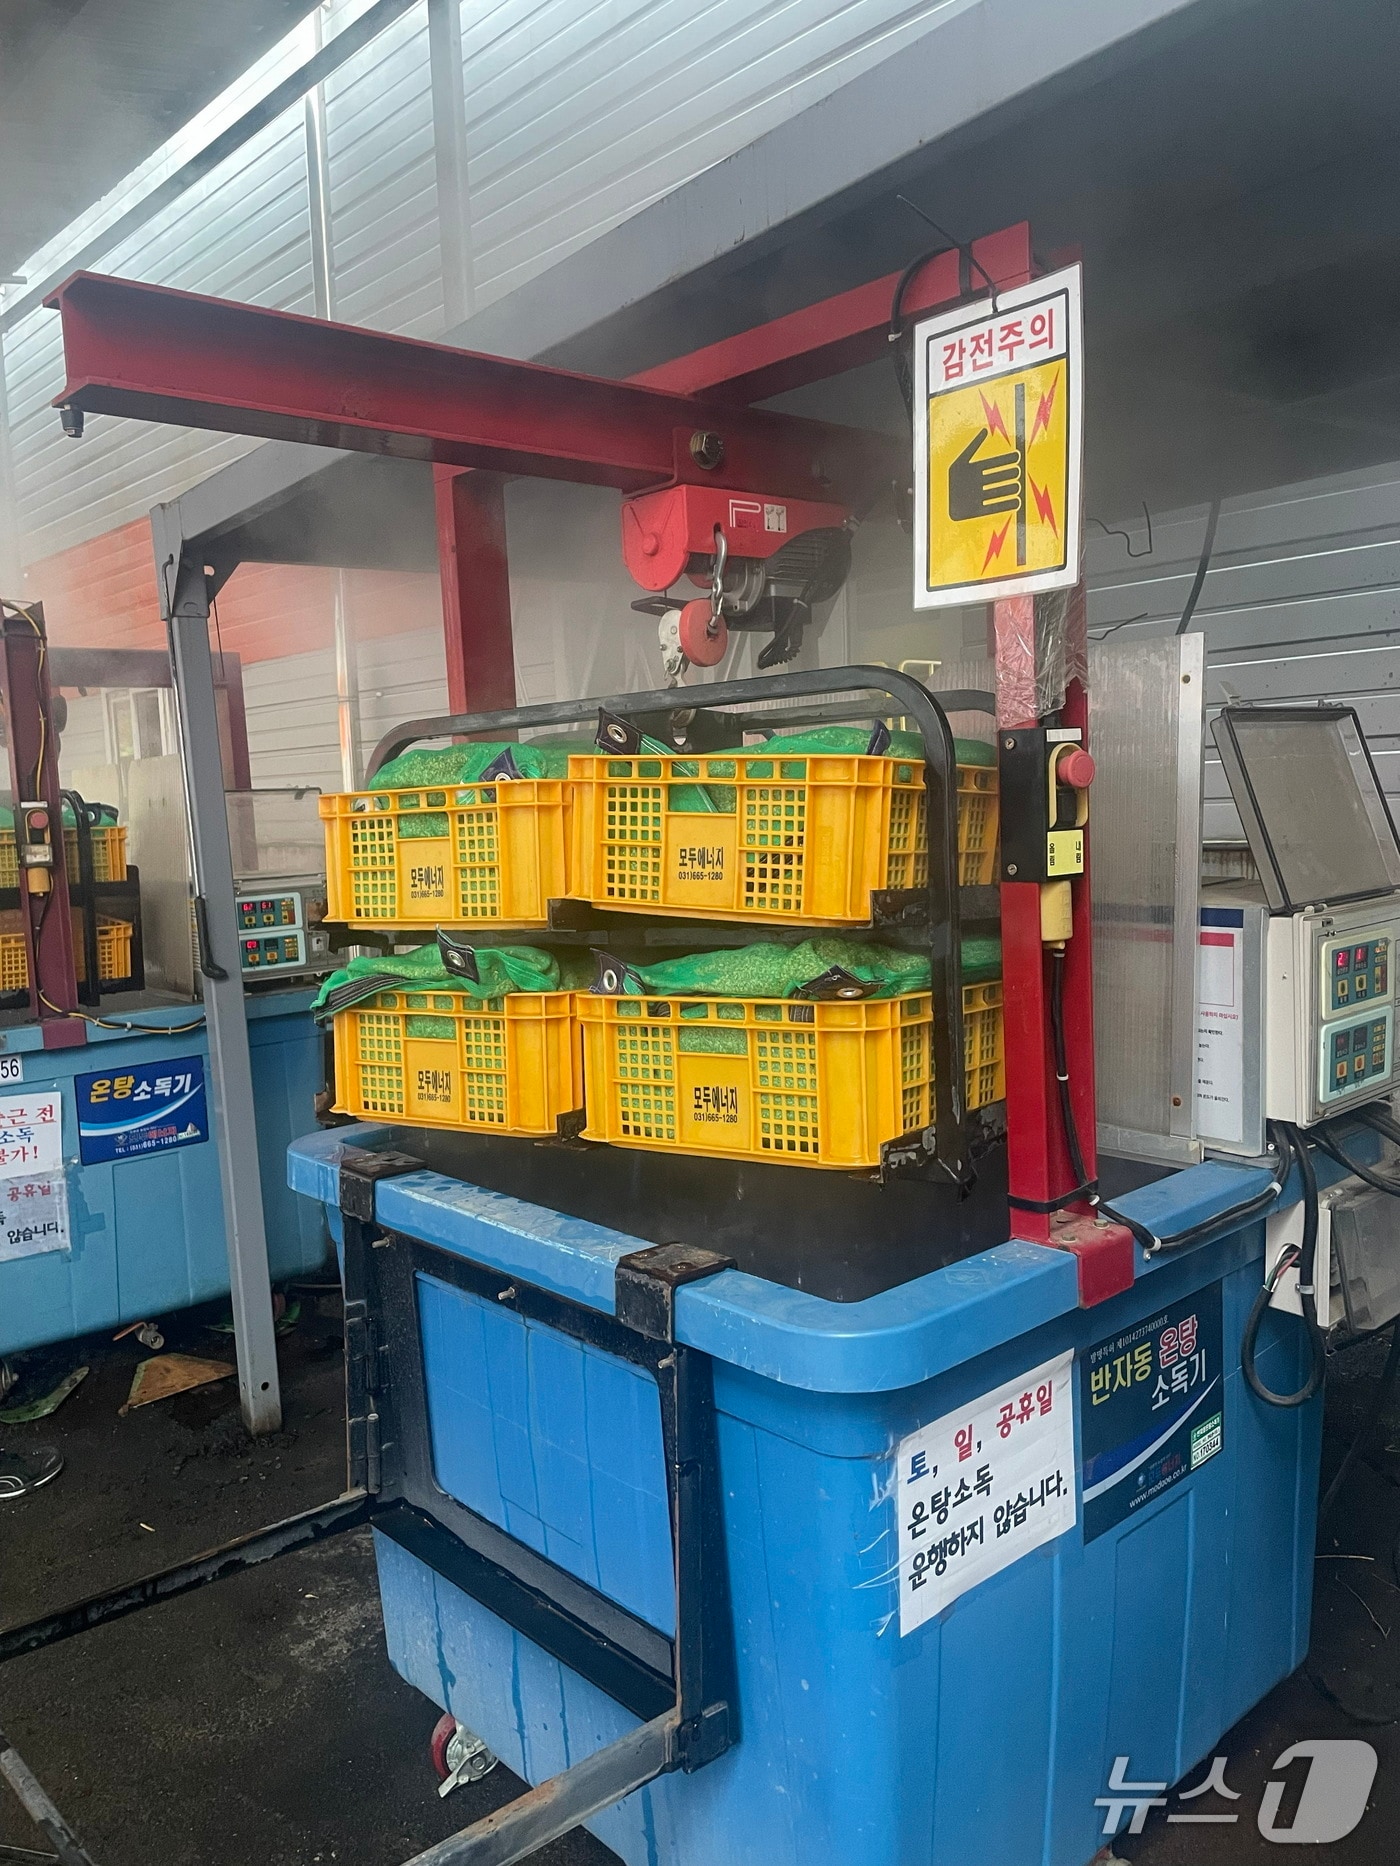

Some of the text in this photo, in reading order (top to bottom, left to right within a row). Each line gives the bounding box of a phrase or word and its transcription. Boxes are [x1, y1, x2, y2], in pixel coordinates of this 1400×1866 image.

[942, 308, 1054, 382] 감전주의
[679, 846, 724, 870] 모두에너지
[411, 865, 444, 890] 모두에너지
[678, 871, 724, 881] 031)665-1280
[418, 1070, 451, 1094] 모두에너지
[694, 1086, 738, 1114] 모두에너지
[36, 1104, 57, 1123] 전
[694, 1112, 738, 1124] 031)665-1280
[7, 1221, 65, 1245] 않습니다.
[1091, 1314, 1198, 1406] 반자동 온탕
[1151, 1348, 1206, 1411] 소독기
[907, 1380, 1053, 1484] 토, 일, 공휴일
[907, 1463, 994, 1540] 온탕소독
[908, 1469, 1068, 1591] 운행하지 않습니다.
